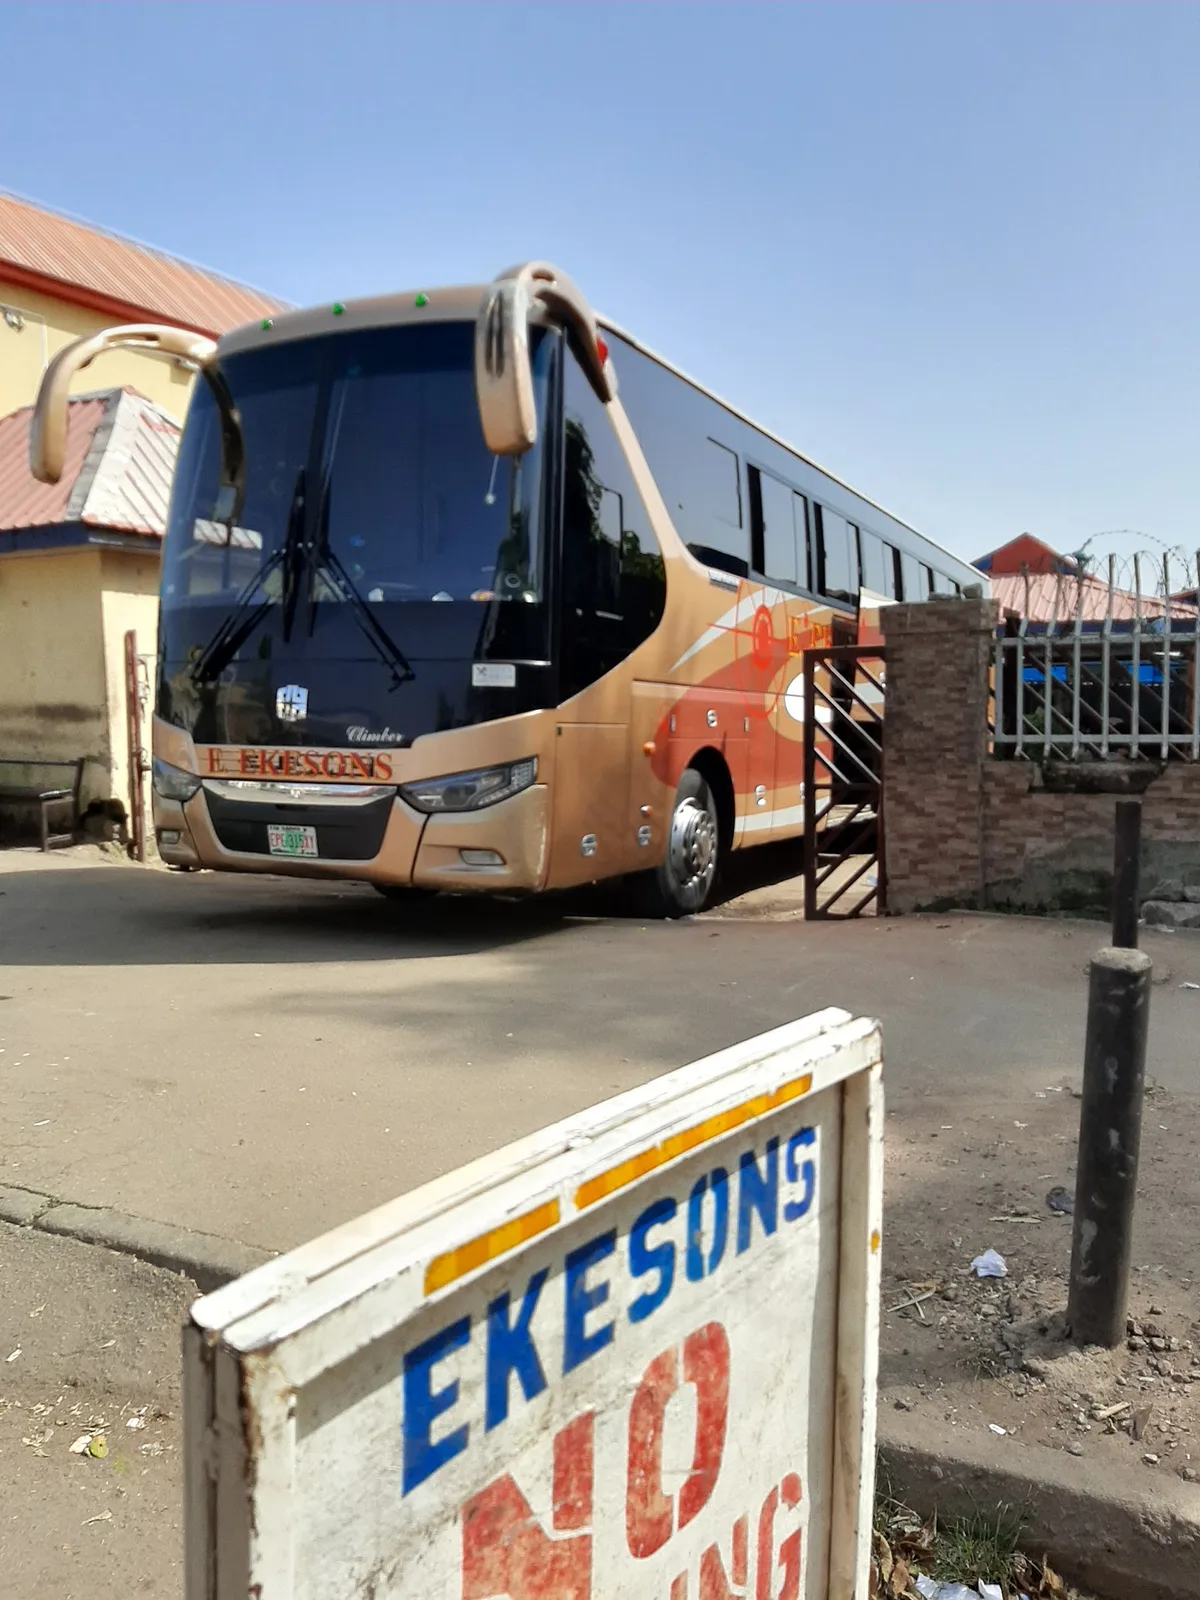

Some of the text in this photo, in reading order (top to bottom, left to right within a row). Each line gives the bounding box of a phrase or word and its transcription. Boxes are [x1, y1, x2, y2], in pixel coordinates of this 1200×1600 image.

[239, 748, 393, 781] EKESONS
[346, 725, 404, 743] Climber
[402, 1126, 817, 1498] EKESONS
[461, 1321, 730, 1600] NO
